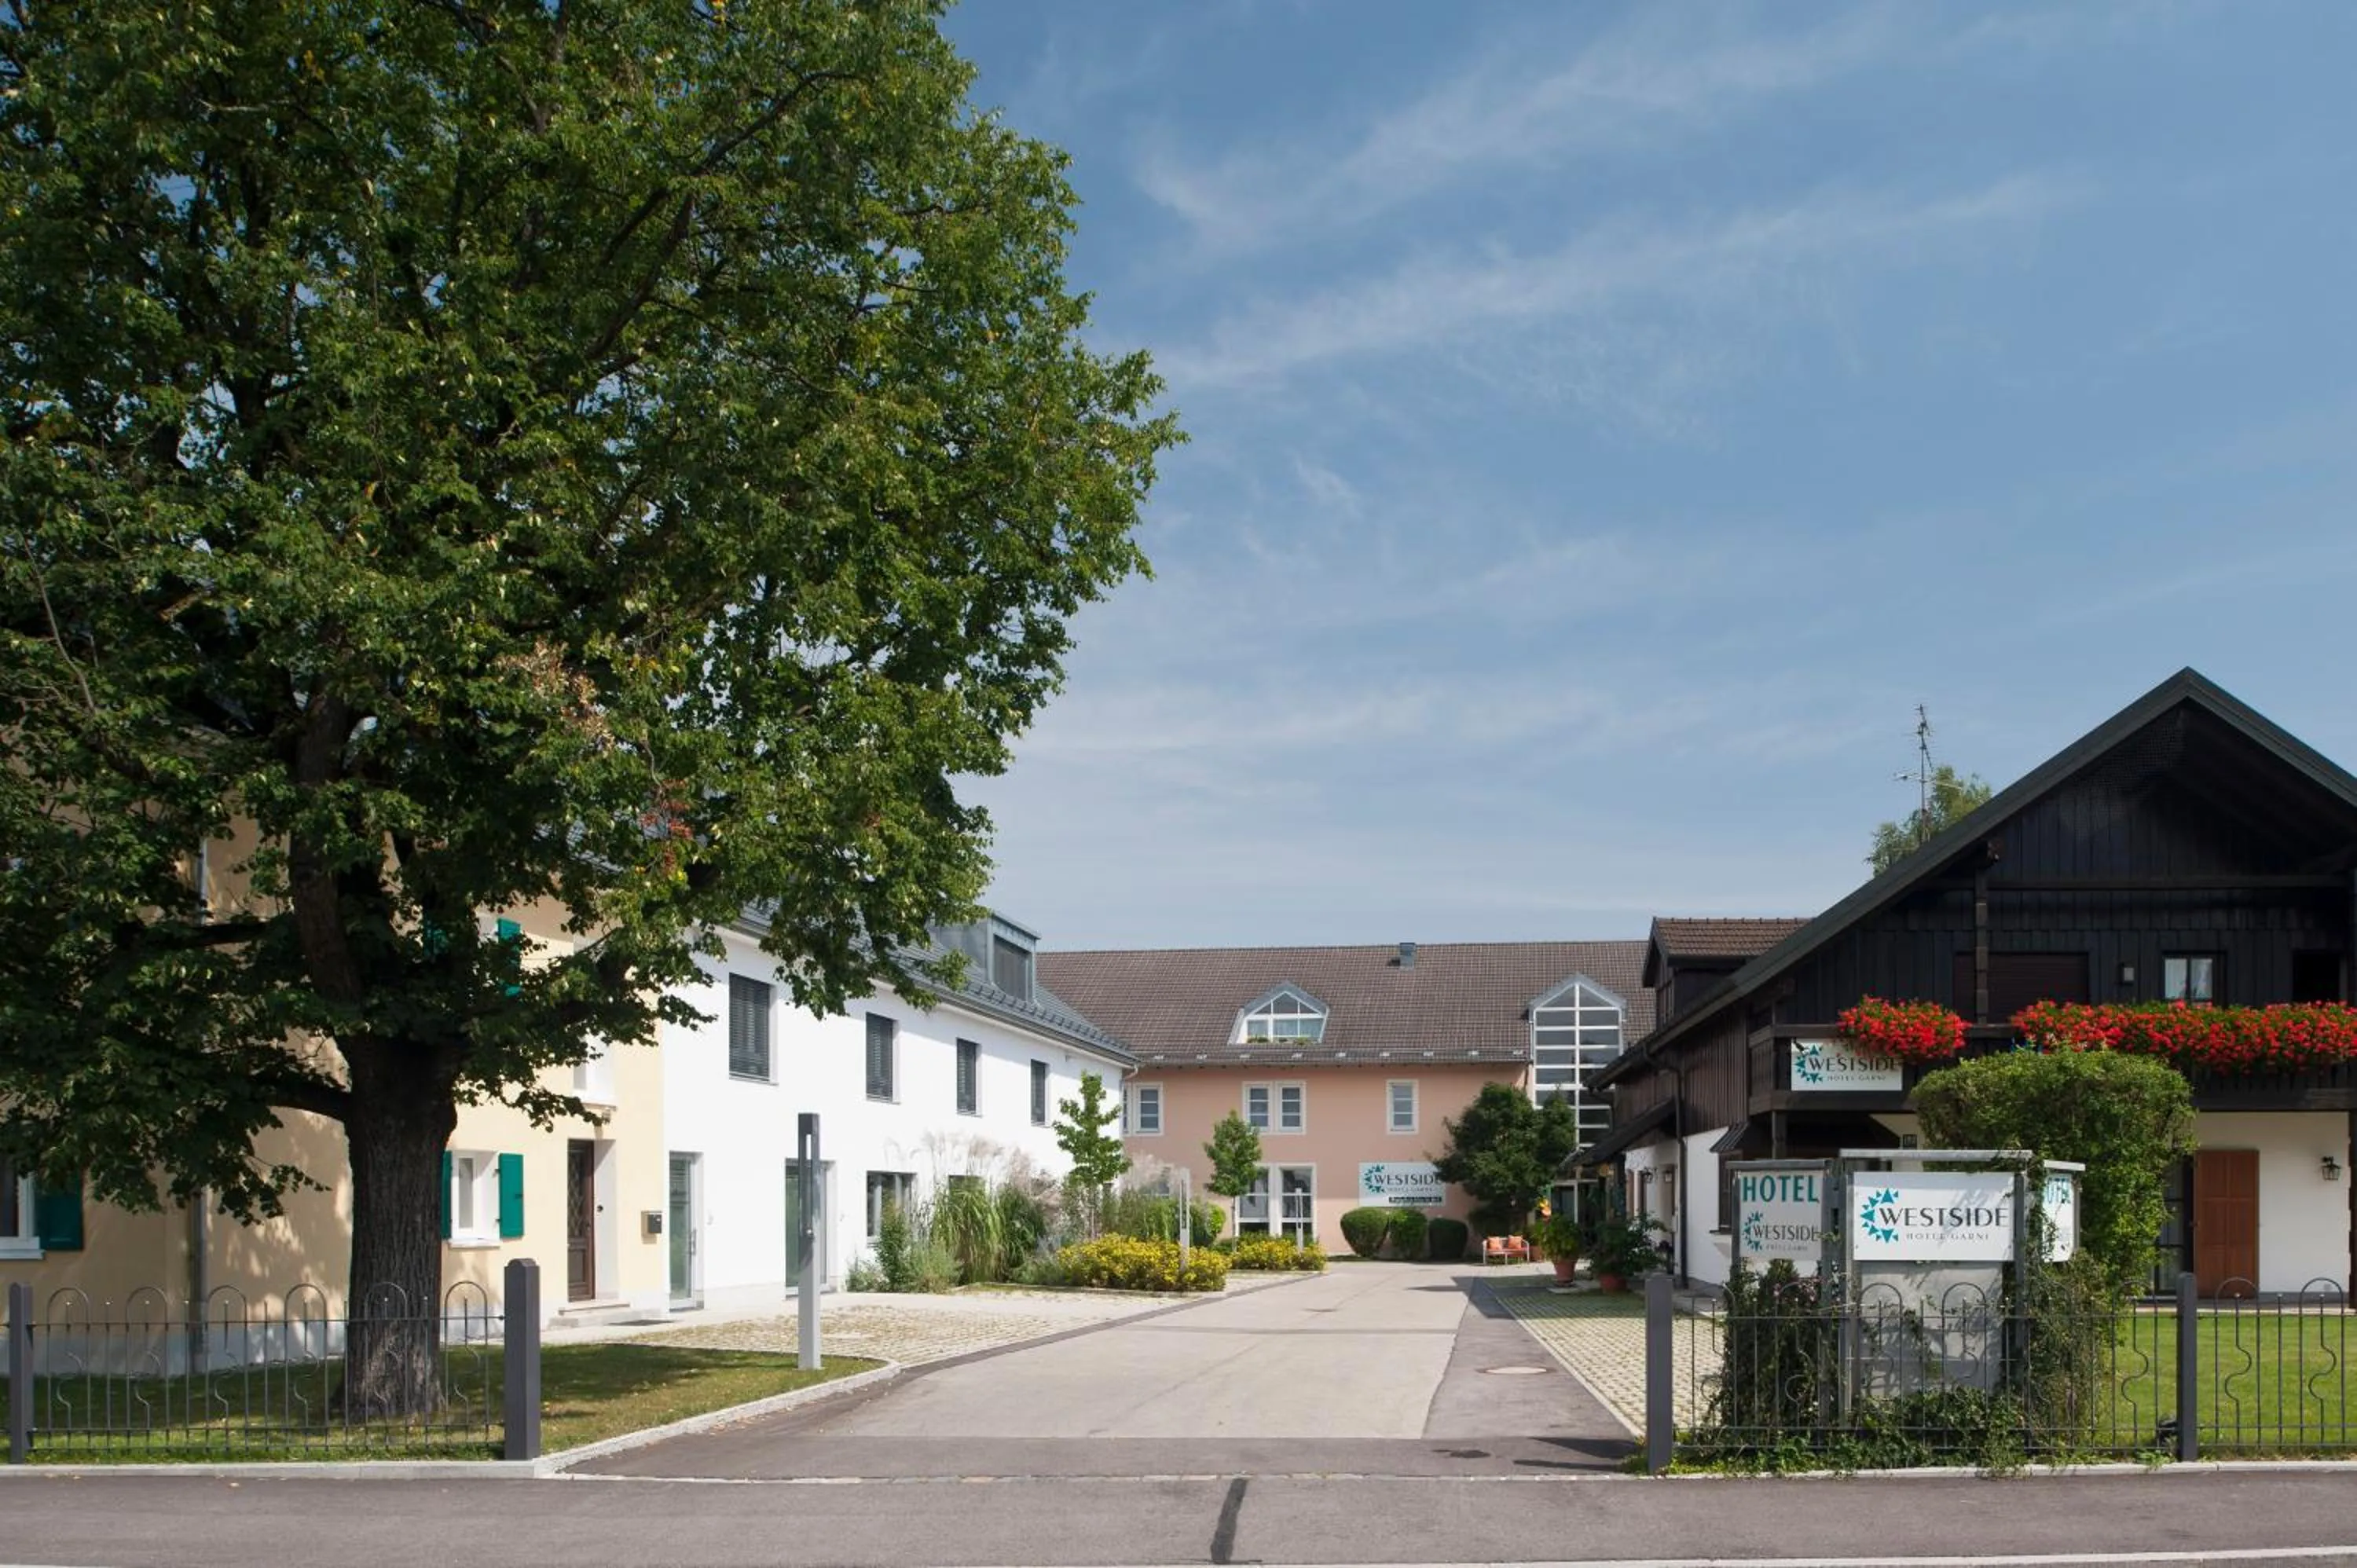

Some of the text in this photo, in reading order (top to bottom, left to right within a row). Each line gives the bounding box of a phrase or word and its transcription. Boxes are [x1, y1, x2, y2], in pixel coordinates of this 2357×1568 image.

[1743, 1174, 1820, 1203] HOTEL
[1879, 1207, 2010, 1227] WESTSIDE
[1752, 1225, 1820, 1242] WESTSIDE
[1950, 1232, 1989, 1240] GARNI
